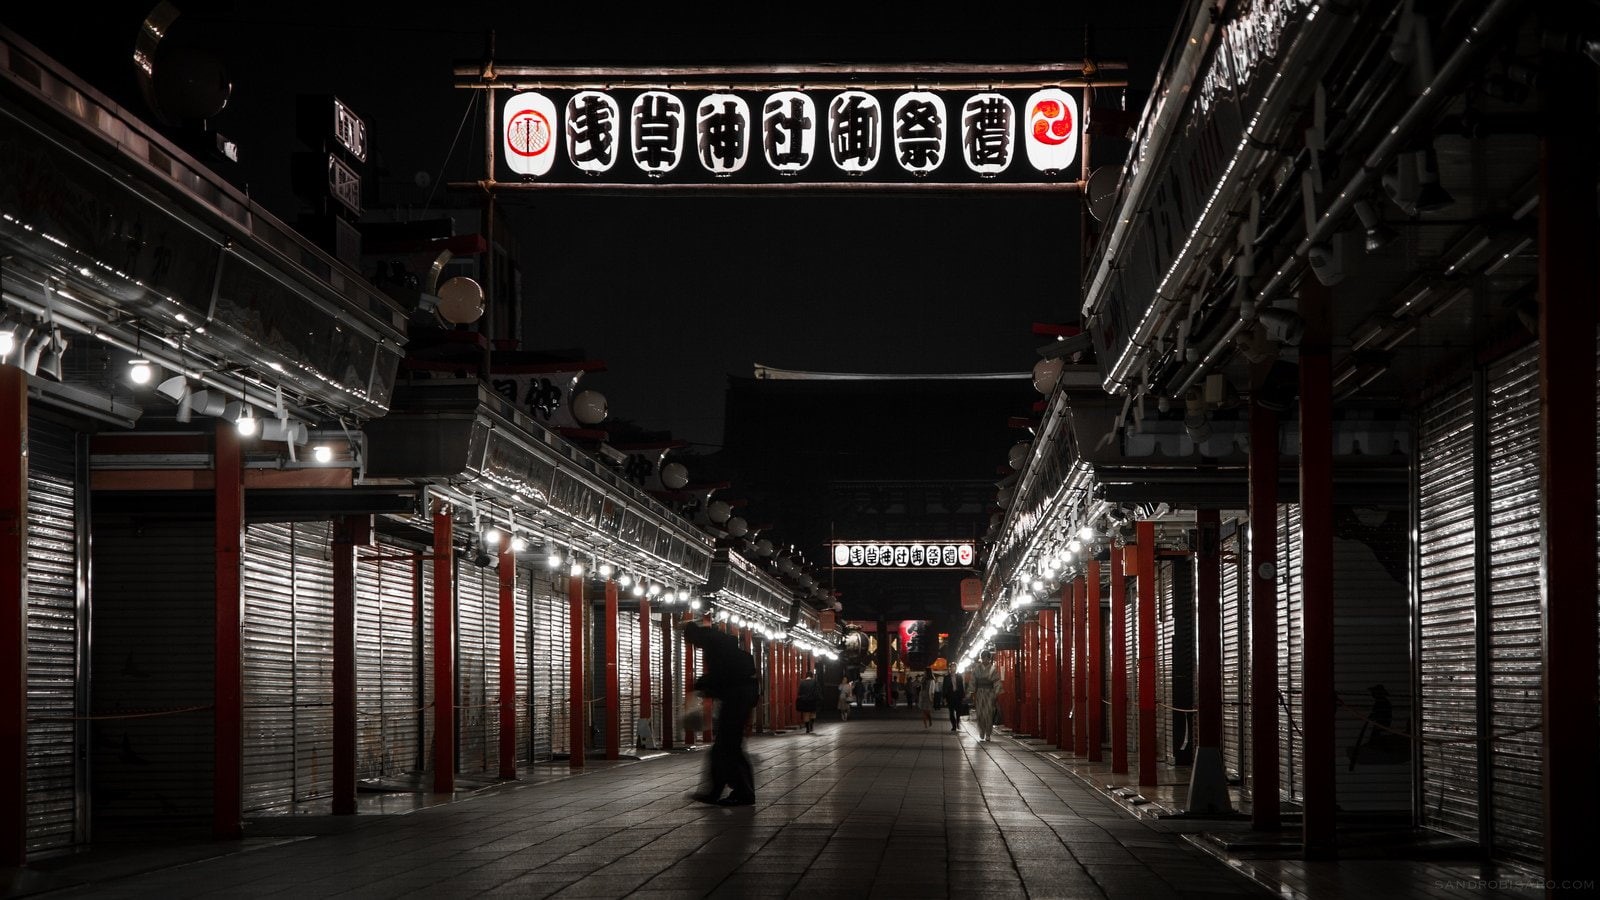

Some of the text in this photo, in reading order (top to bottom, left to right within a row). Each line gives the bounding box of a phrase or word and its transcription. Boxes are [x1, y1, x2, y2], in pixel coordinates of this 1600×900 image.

[568, 95, 1012, 168] 浅草神社御祭禮
